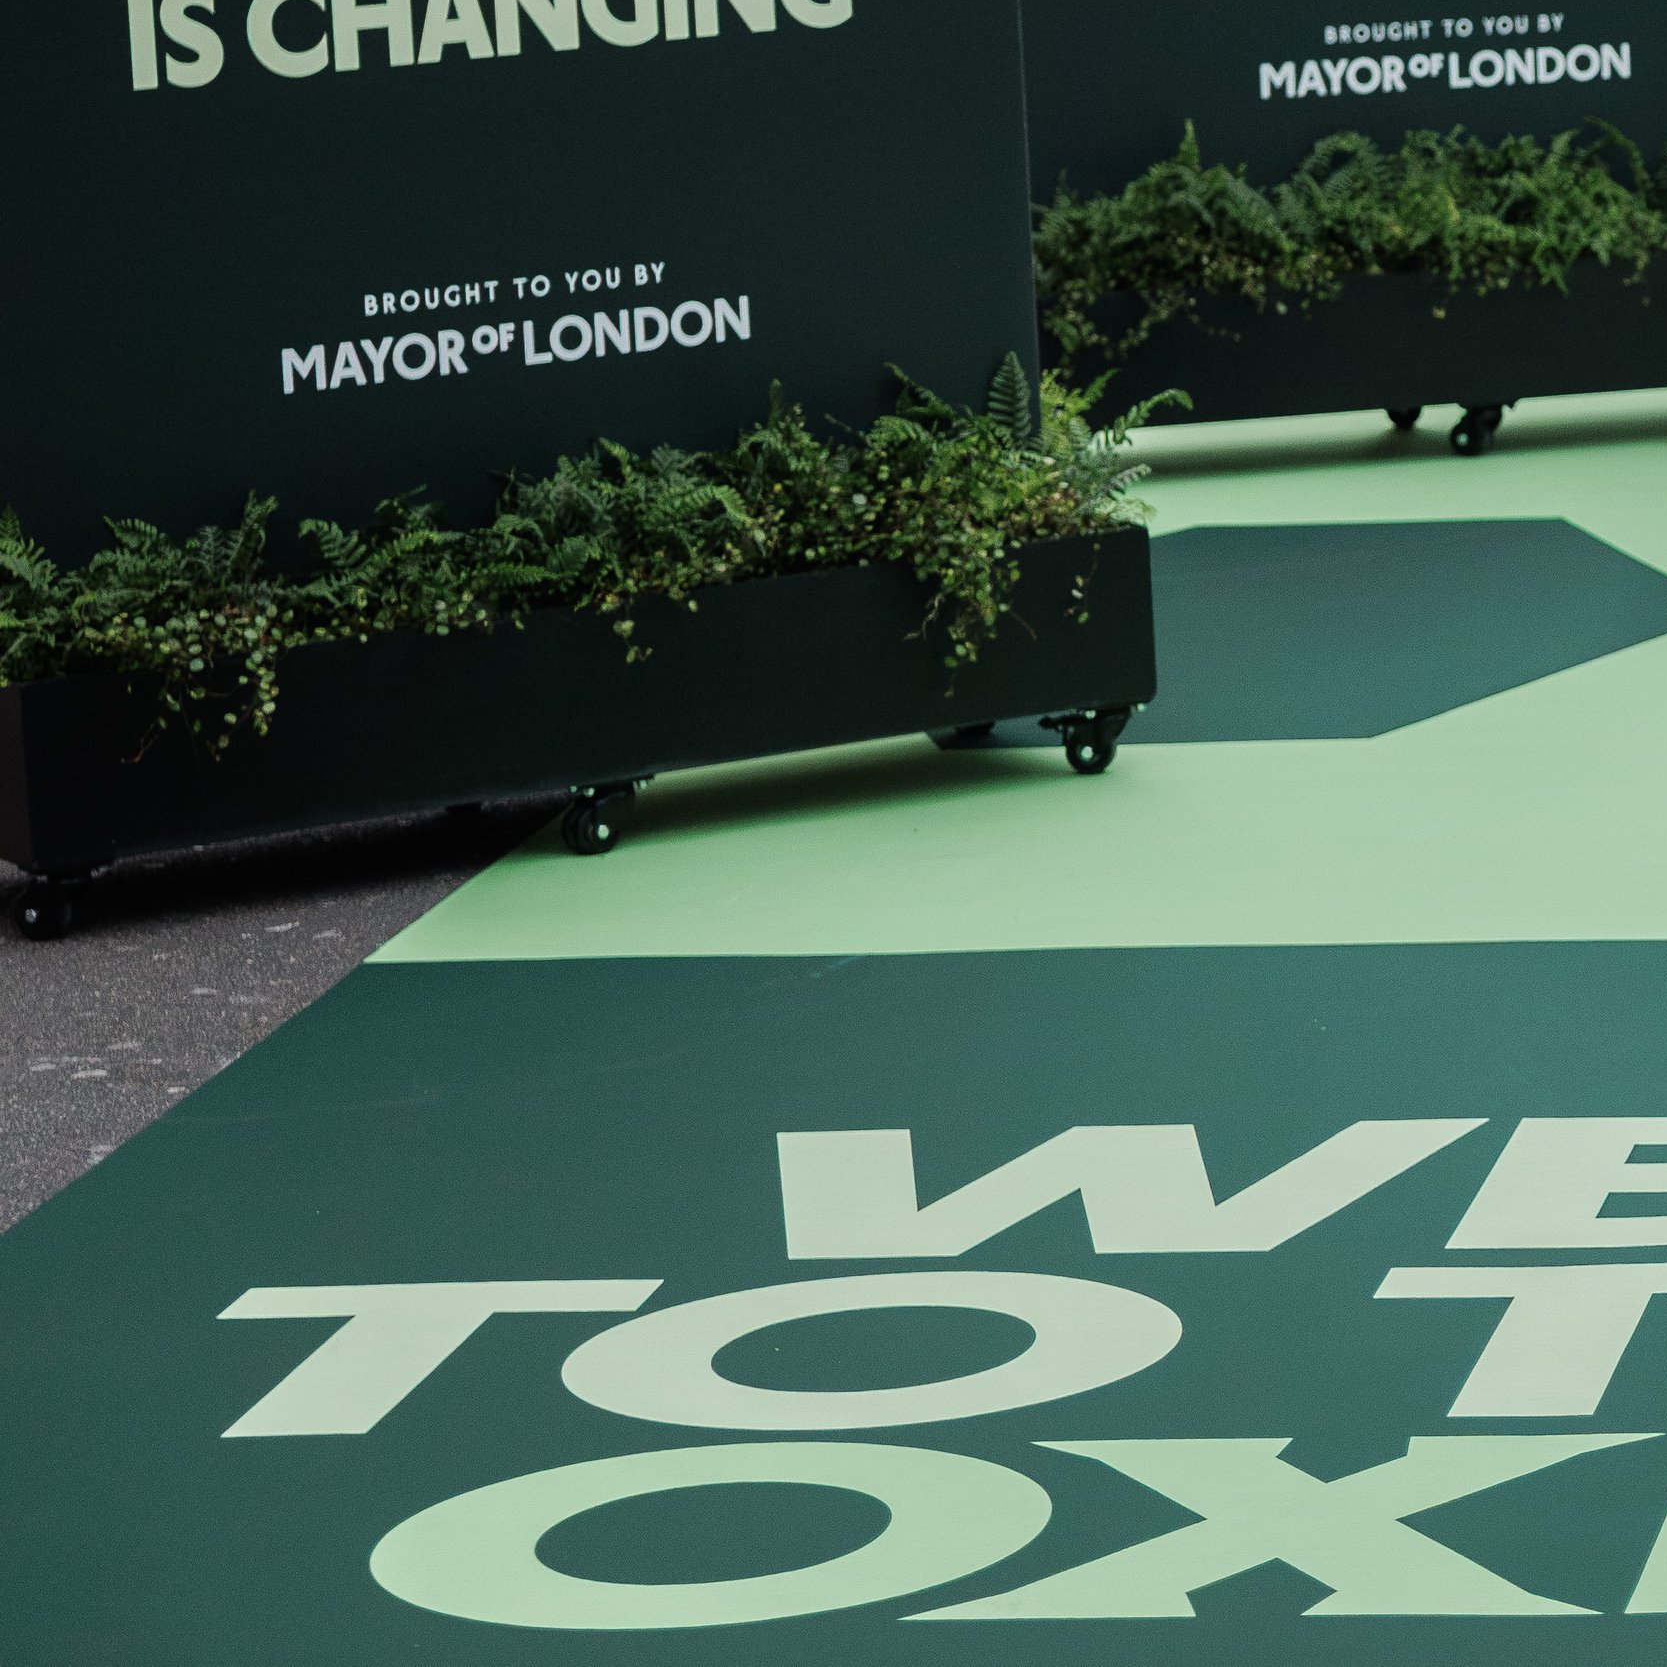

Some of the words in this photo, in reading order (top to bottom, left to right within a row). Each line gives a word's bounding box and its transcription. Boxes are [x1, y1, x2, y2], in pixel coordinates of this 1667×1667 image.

[1324, 20, 1433, 45] BROUGHT
[1441, 18, 1473, 37] TO
[1482, 15, 1529, 35] YOU
[1537, 13, 1564, 33] BY
[365, 281, 498, 316] BROUGHT
[513, 275, 550, 299] TO
[565, 267, 620, 293] YOU
[635, 262, 665, 286] BY
[217, 1278, 1184, 1437] TO
